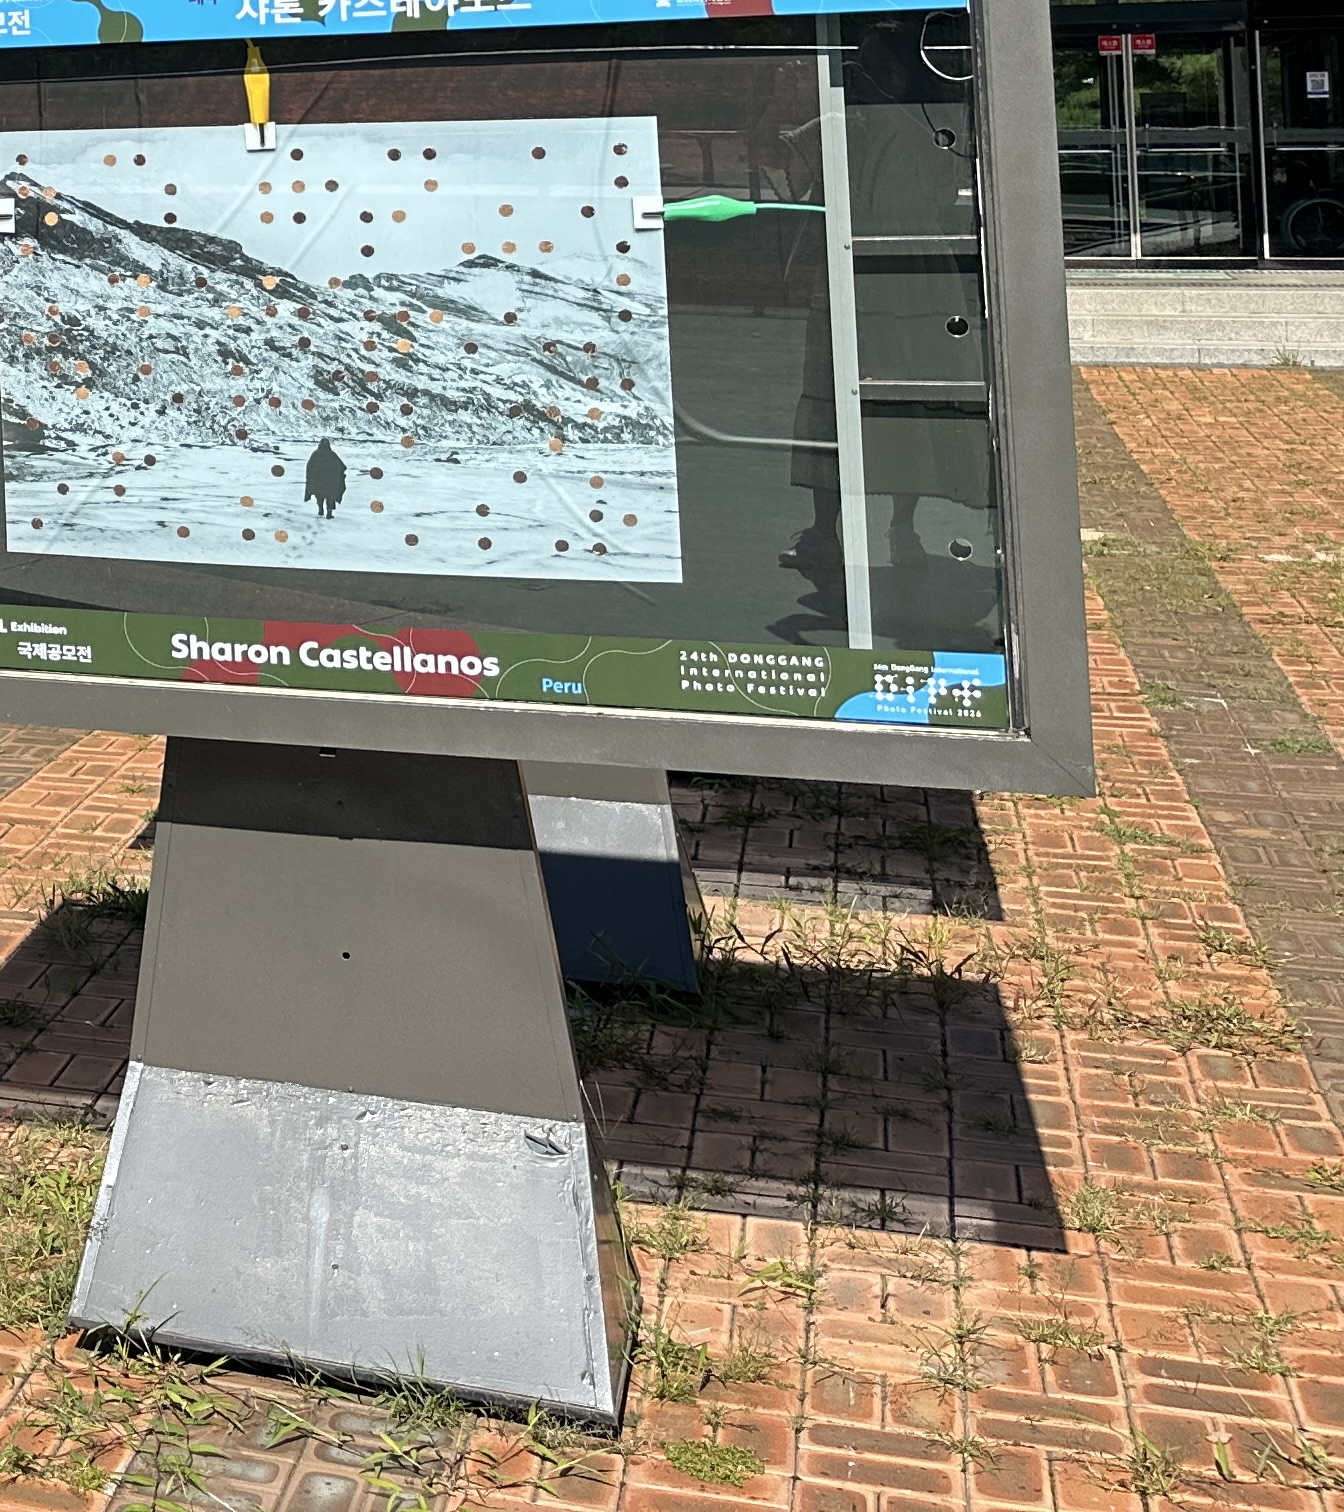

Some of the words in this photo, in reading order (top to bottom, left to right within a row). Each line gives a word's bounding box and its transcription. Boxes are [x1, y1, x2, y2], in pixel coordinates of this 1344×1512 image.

[10, 621, 68, 636] Exhibition
[16, 641, 93, 663] 국제공모전
[170, 633, 291, 666] Sharon
[298, 641, 500, 678] Castellanos
[679, 650, 718, 662] 24th
[727, 652, 824, 667] DONGGANG
[680, 665, 825, 682] International
[541, 677, 583, 695] Peru
[681, 679, 736, 693] Photo
[746, 682, 826, 697] Festival
[876, 704, 907, 714] Photo
